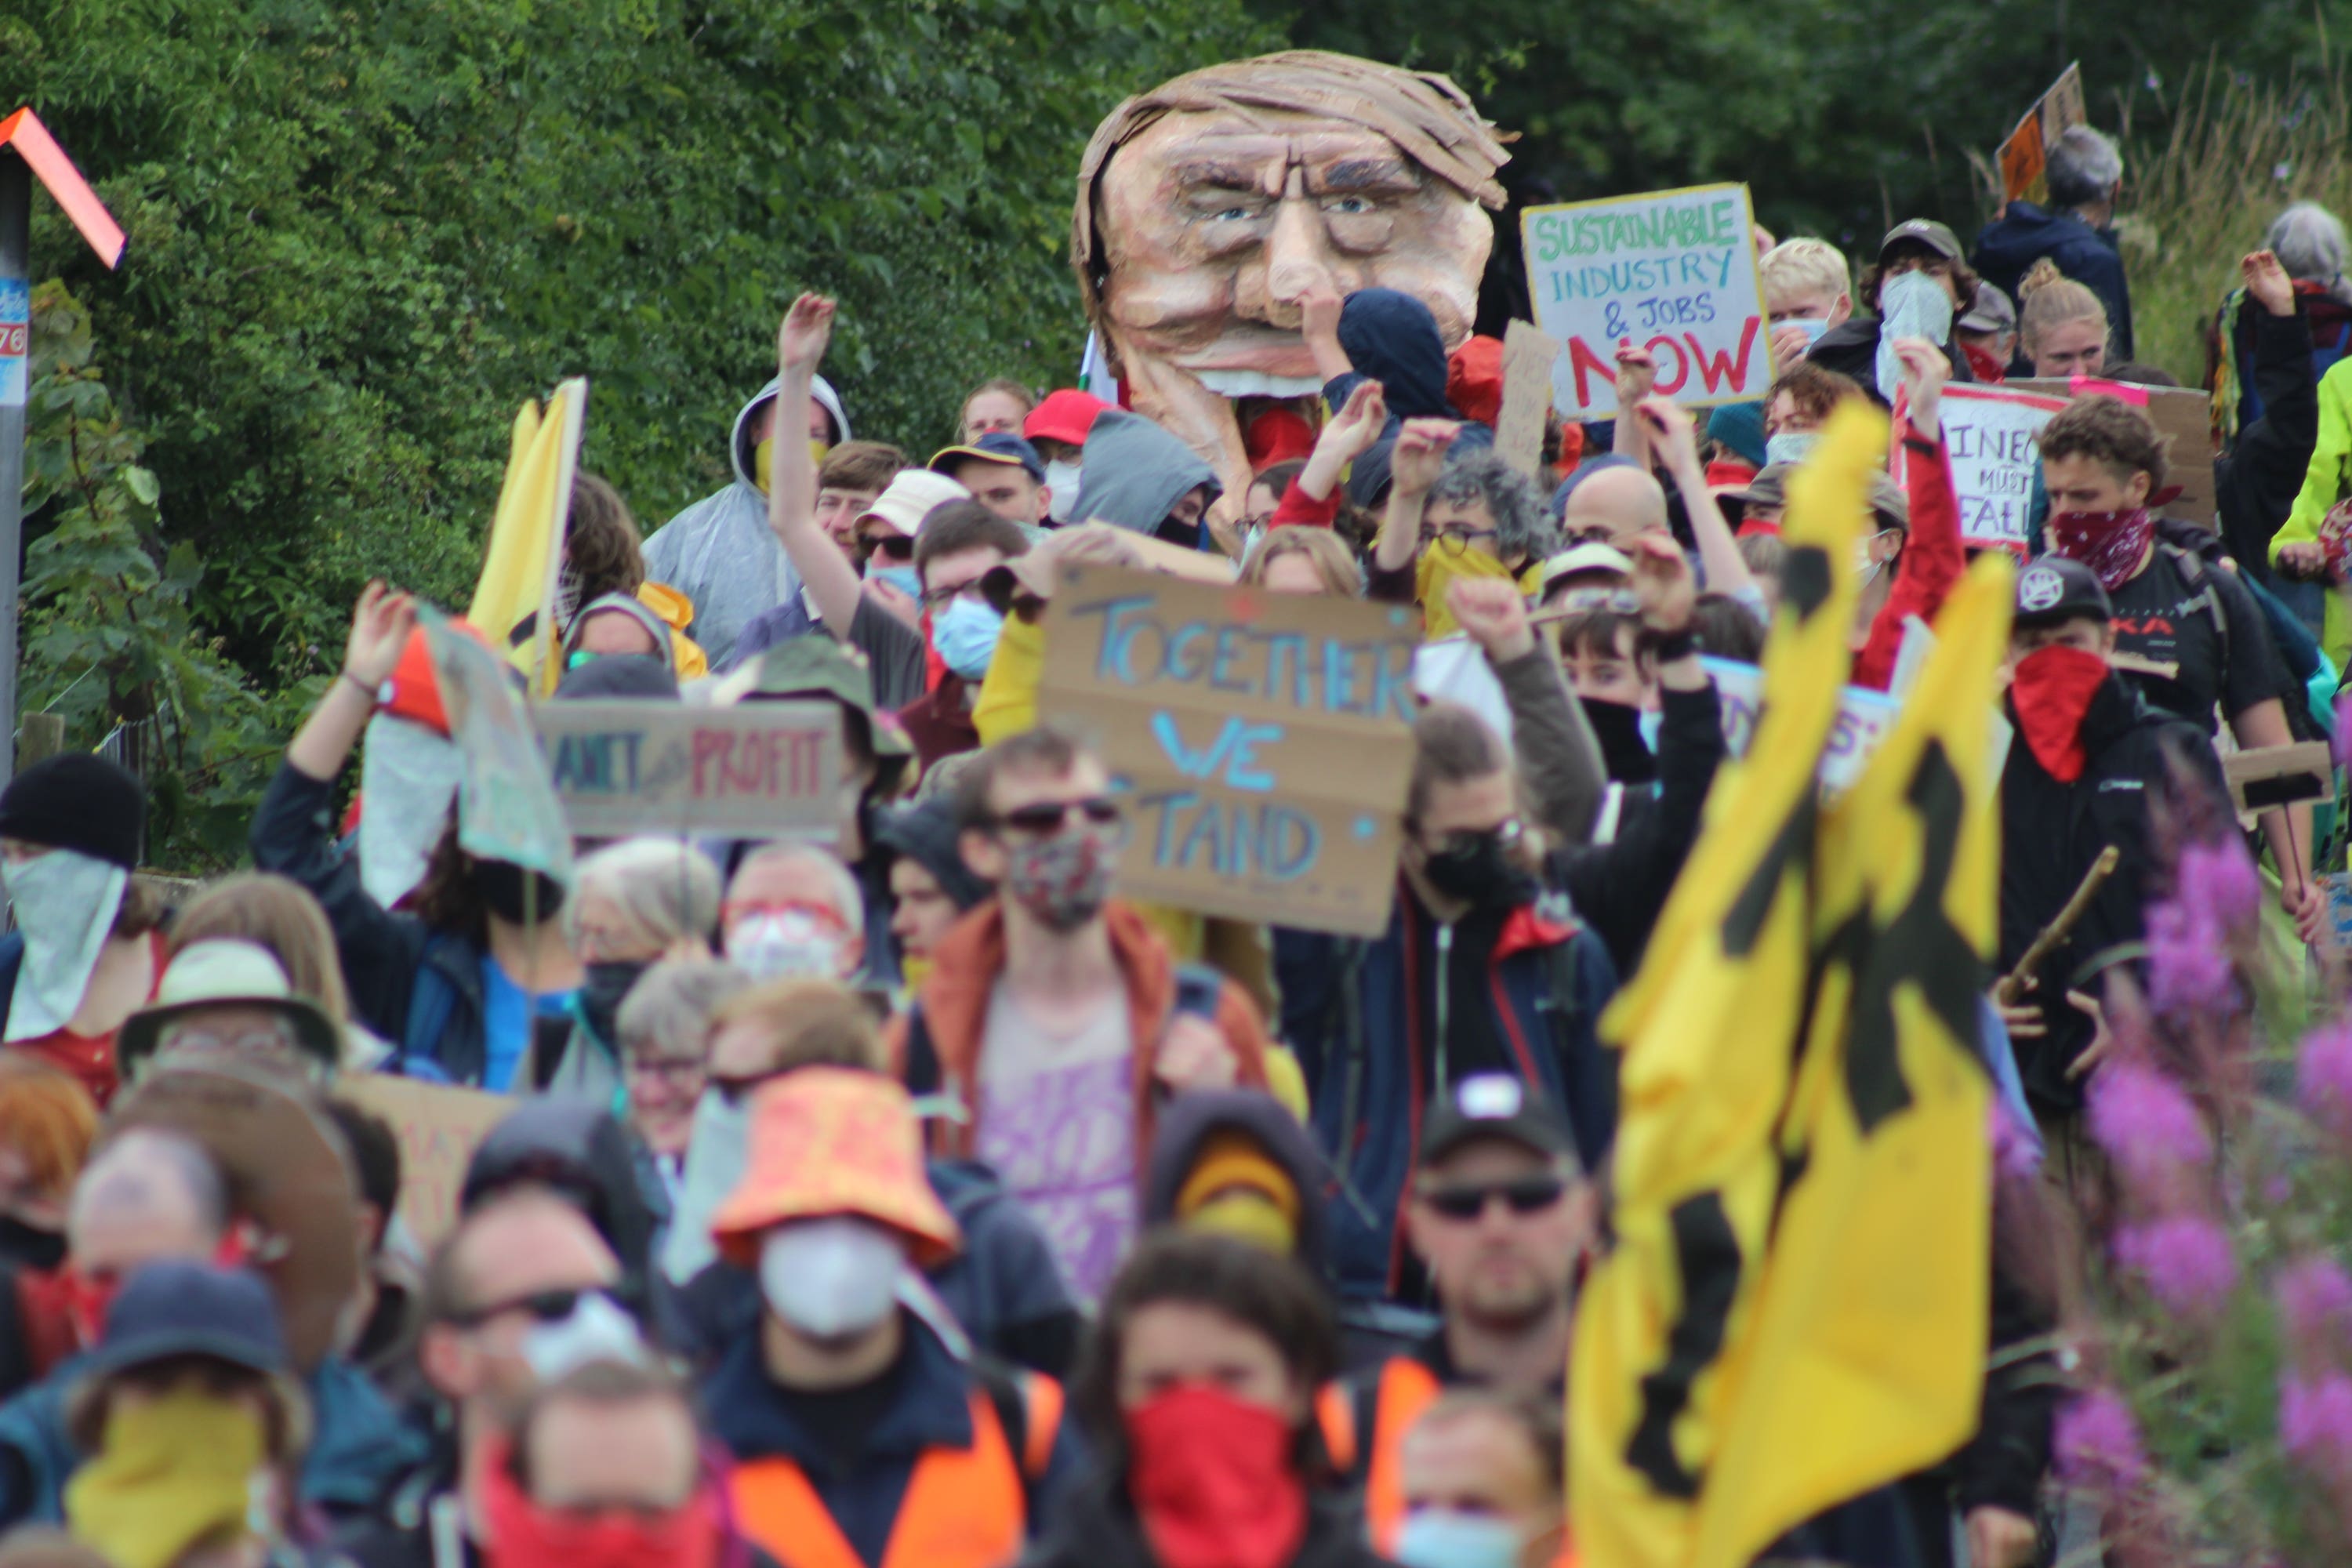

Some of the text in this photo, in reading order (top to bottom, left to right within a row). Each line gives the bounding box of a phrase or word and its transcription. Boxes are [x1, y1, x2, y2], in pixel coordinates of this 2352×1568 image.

[1535, 200, 1739, 262] SUSTAINABLE
[1550, 249, 1733, 302] INDUSTRY
[1604, 291, 1716, 339] & JOBS
[1568, 315, 1762, 408] NOW
[1980, 469, 2033, 495] MUST
[1069, 593, 1416, 721] TOGETHER
[691, 728, 826, 797] PROFIT
[1151, 711, 1284, 792] WE
